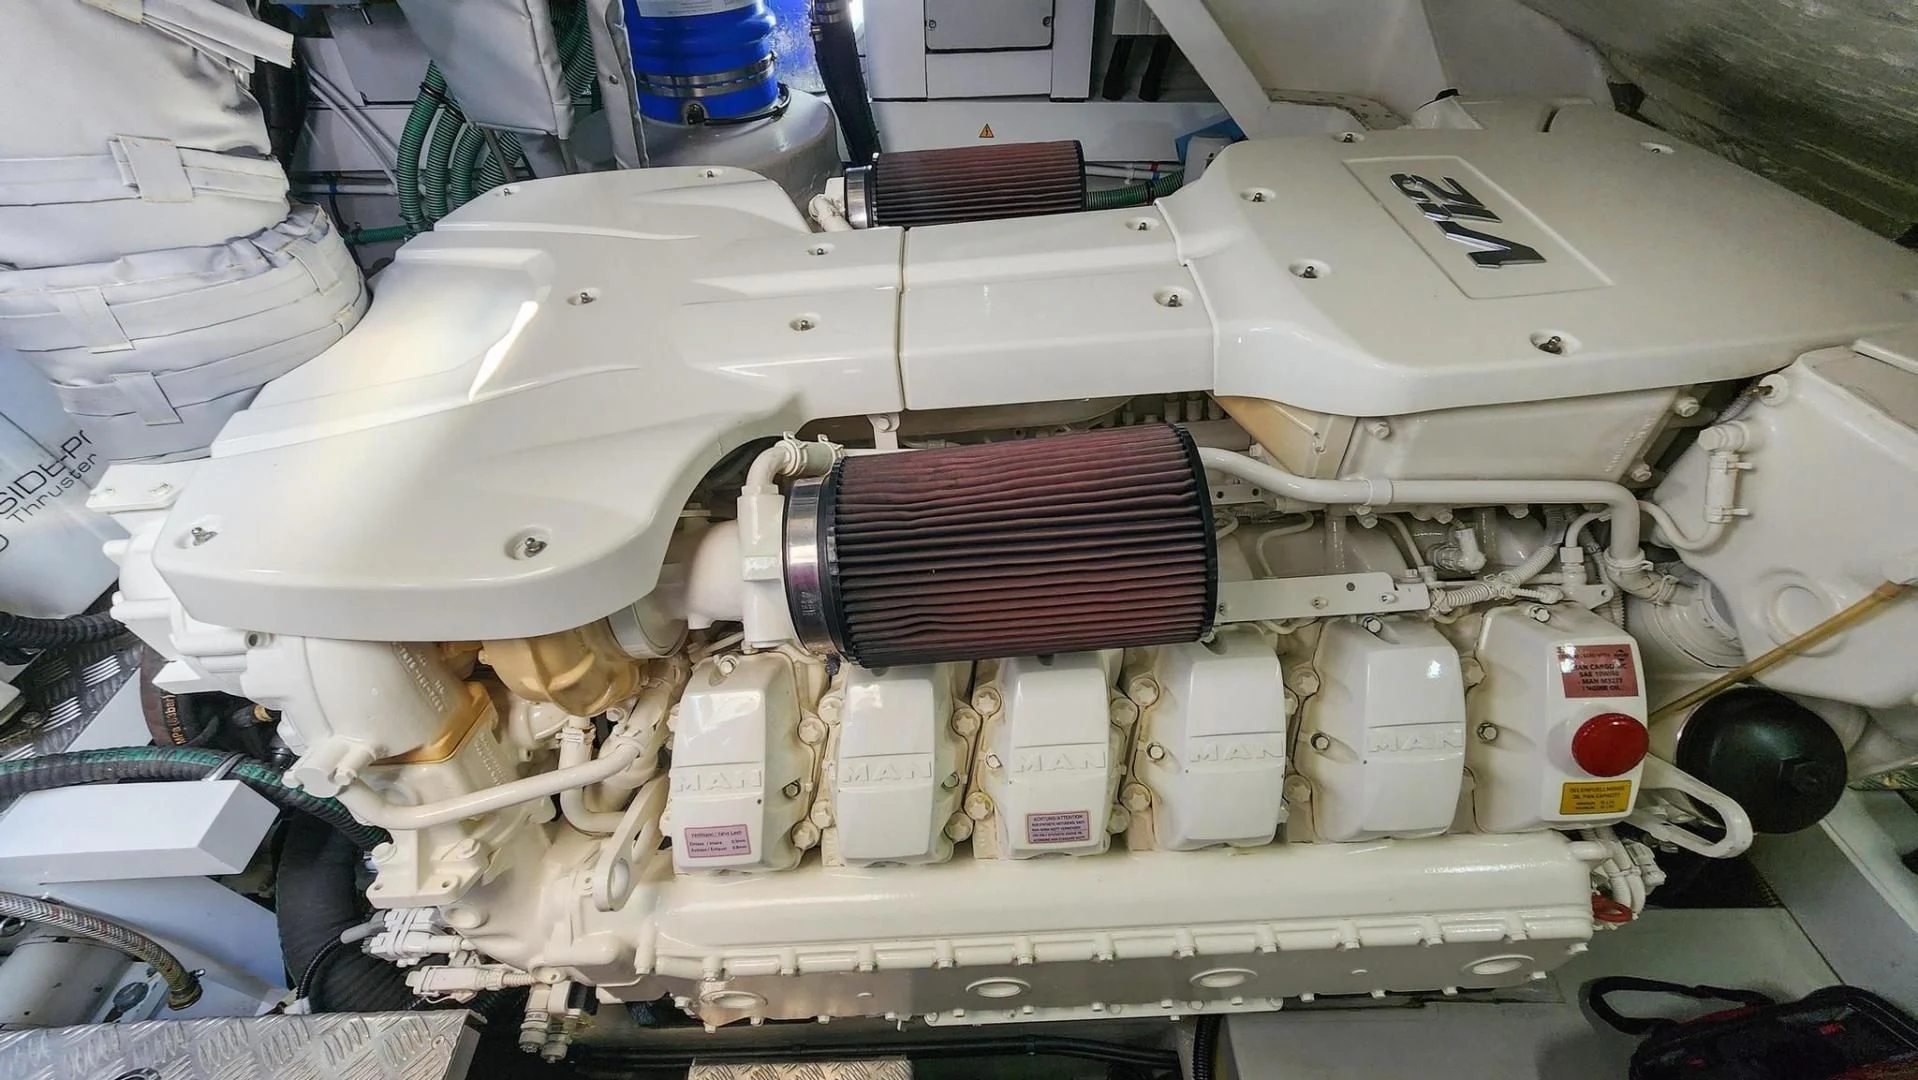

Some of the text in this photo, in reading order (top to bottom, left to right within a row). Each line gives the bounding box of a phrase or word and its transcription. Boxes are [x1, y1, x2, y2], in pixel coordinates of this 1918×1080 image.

[1390, 173, 1547, 269] V12
[6, 453, 97, 523] Thruster
[841, 760, 932, 783] MAN
[1013, 751, 1106, 773] MAN
[674, 769, 762, 793] MAN
